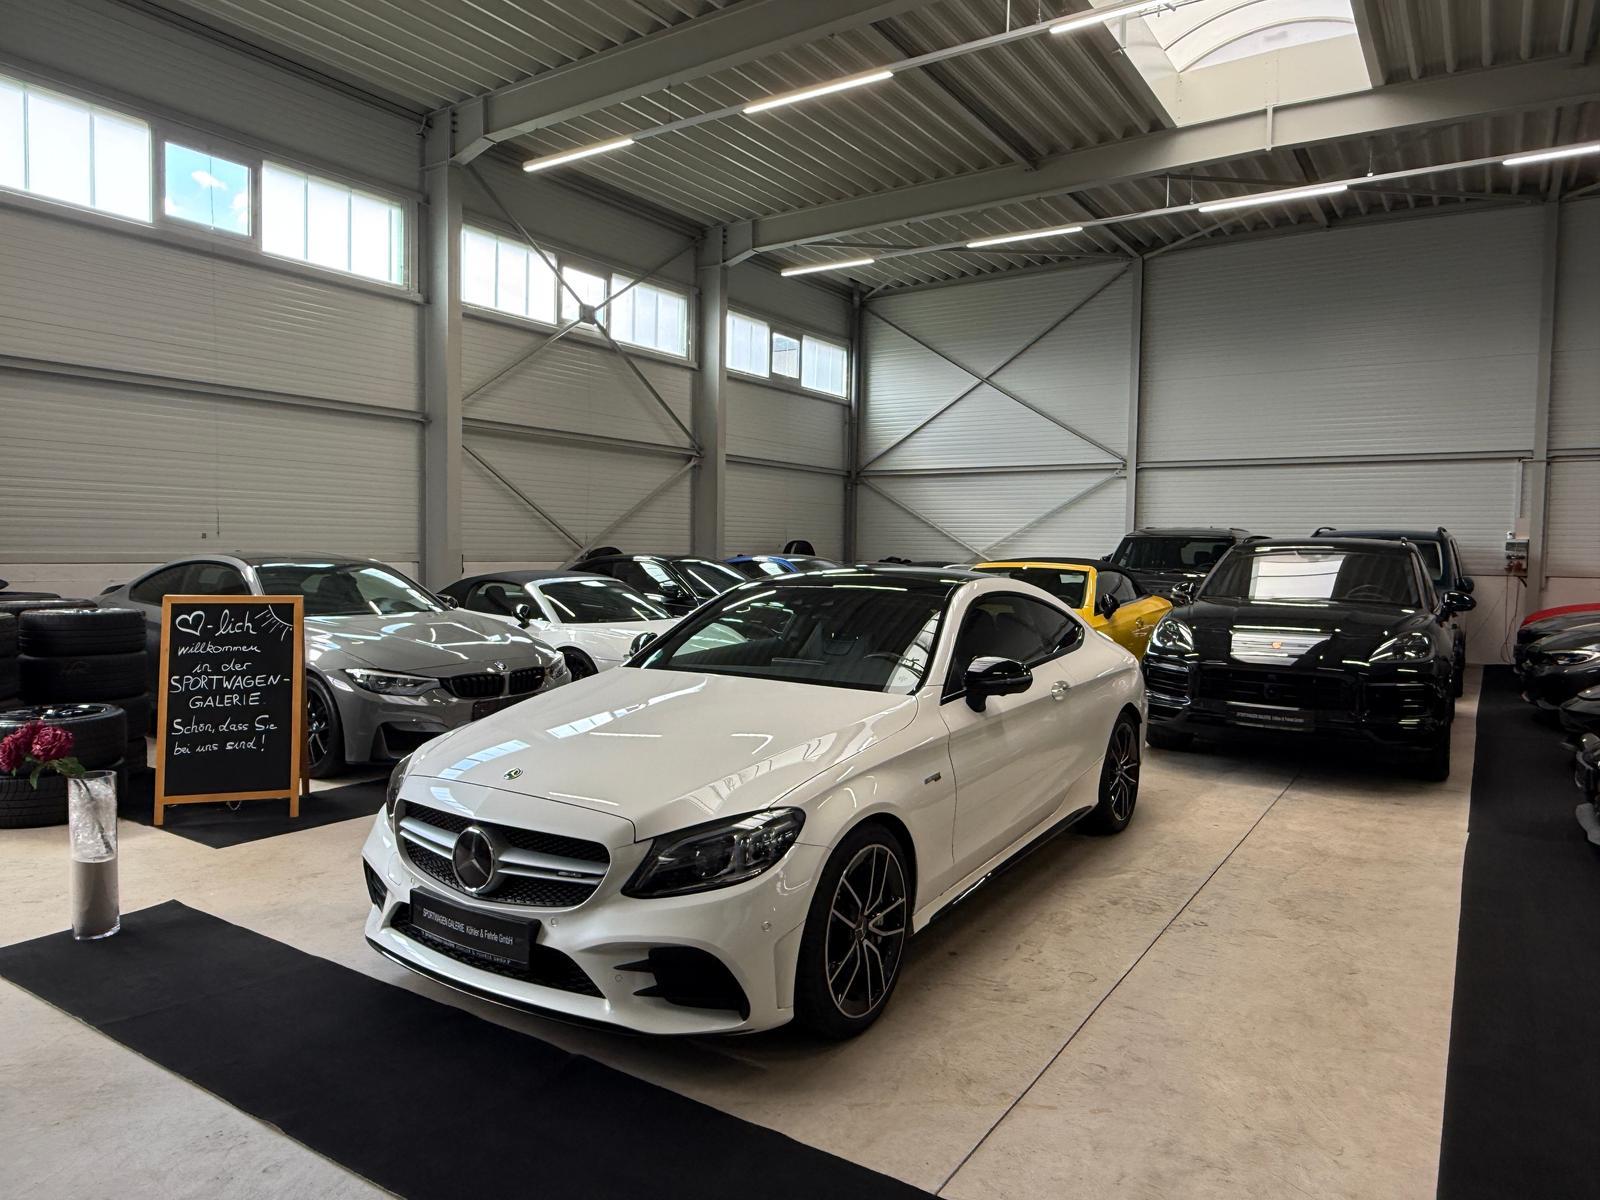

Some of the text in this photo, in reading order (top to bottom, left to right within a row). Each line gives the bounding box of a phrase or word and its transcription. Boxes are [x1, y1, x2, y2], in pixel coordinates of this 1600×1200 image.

[192, 658, 252, 673] in der
[169, 674, 291, 693] SPORTWAGEN-
[188, 692, 261, 709] GALERIE
[171, 714, 278, 735] Schön, dass Sie
[173, 741, 191, 755] bei
[195, 743, 218, 752] uns
